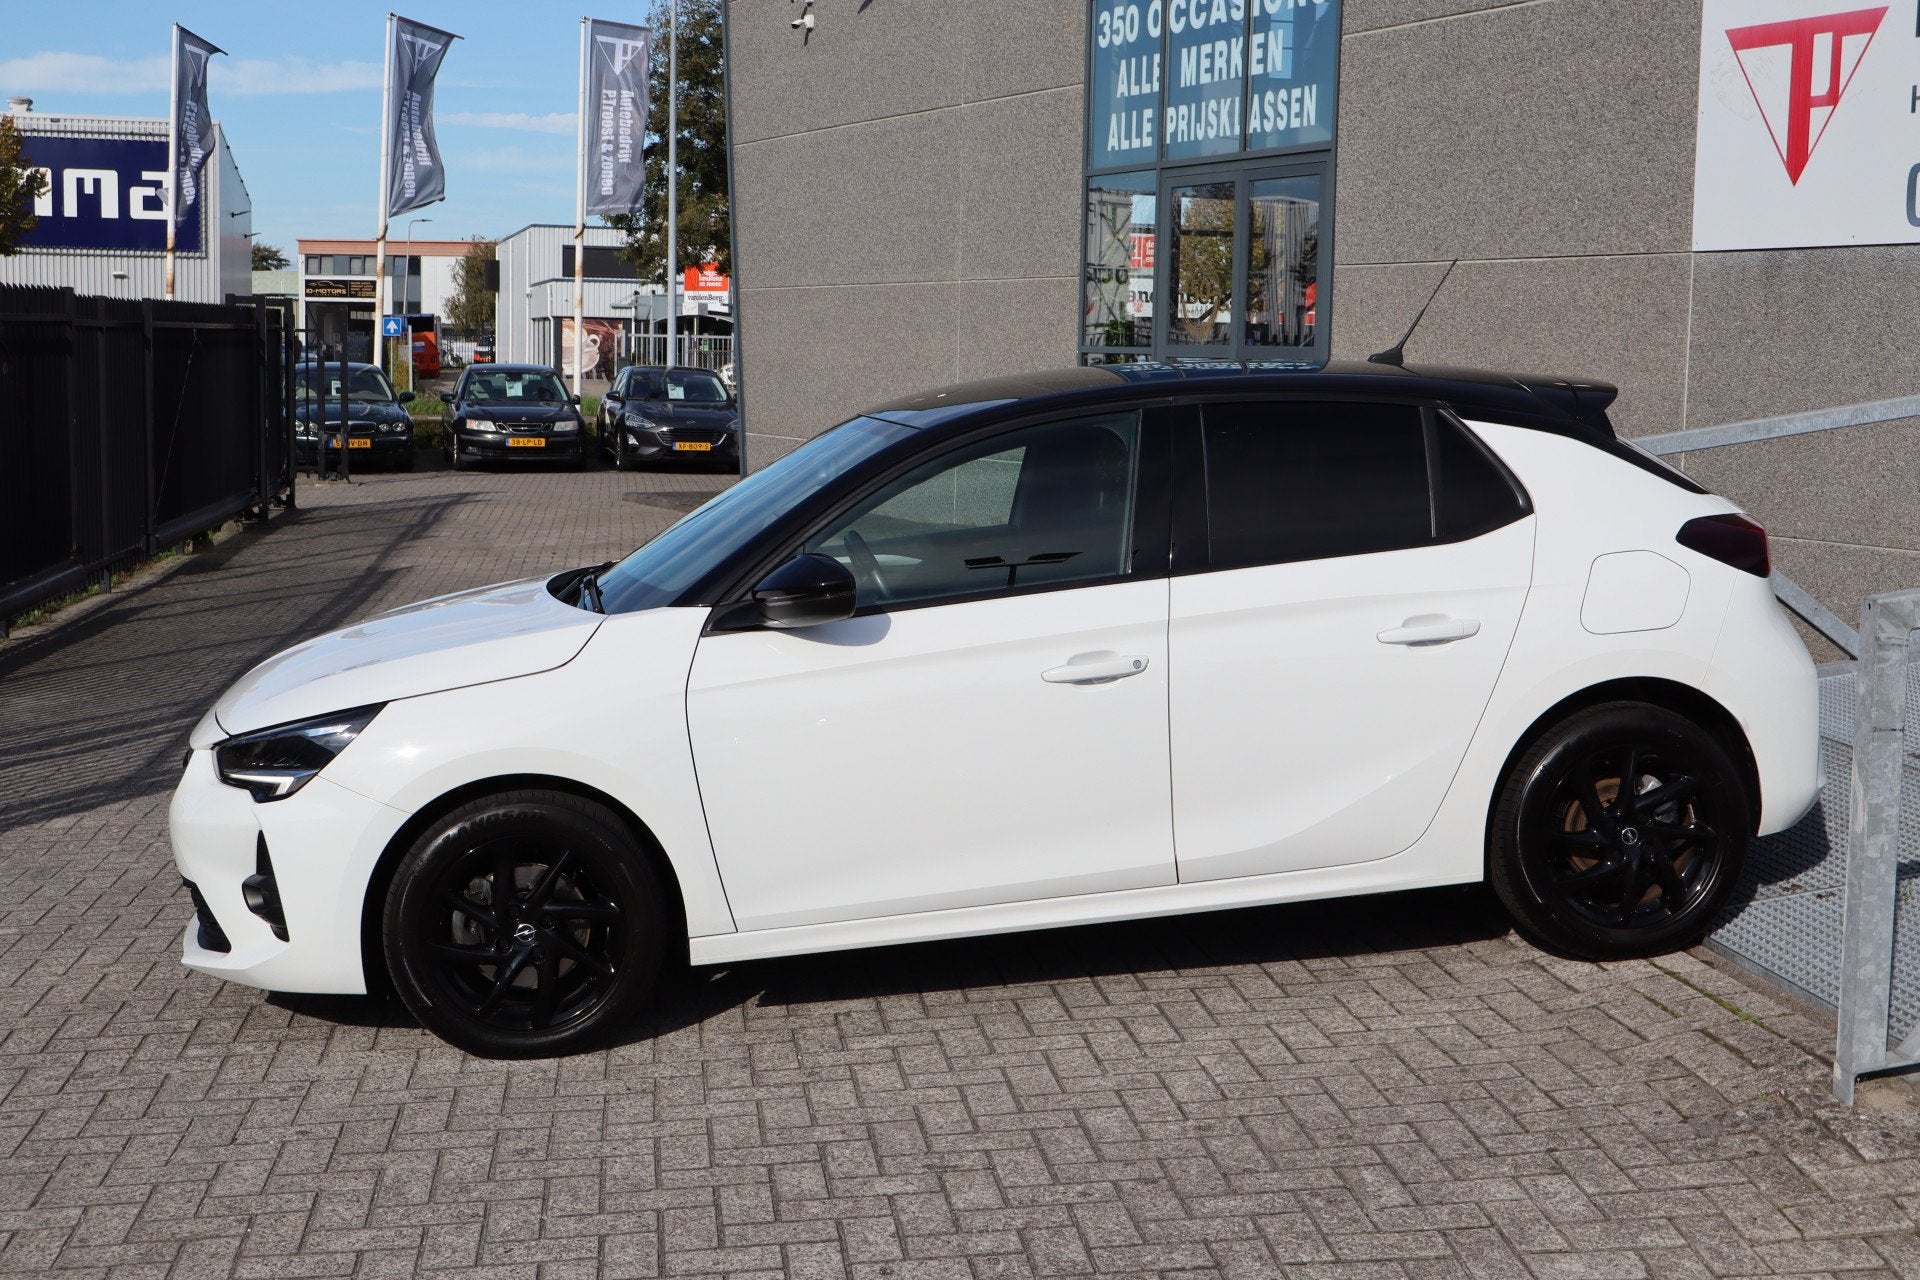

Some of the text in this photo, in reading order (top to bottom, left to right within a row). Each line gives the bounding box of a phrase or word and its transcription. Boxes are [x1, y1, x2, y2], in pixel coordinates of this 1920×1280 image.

[1098, 4, 1139, 48] 350
[1117, 29, 1283, 98] ALLE MERKEN
[411, 91, 433, 167] Autobedrijf
[601, 89, 617, 196] P.Troost & zonen
[617, 89, 635, 164] Autobedrijf
[1107, 84, 1317, 151] ALLE PRIJSKLASSEN
[402, 154, 416, 198] zonen
